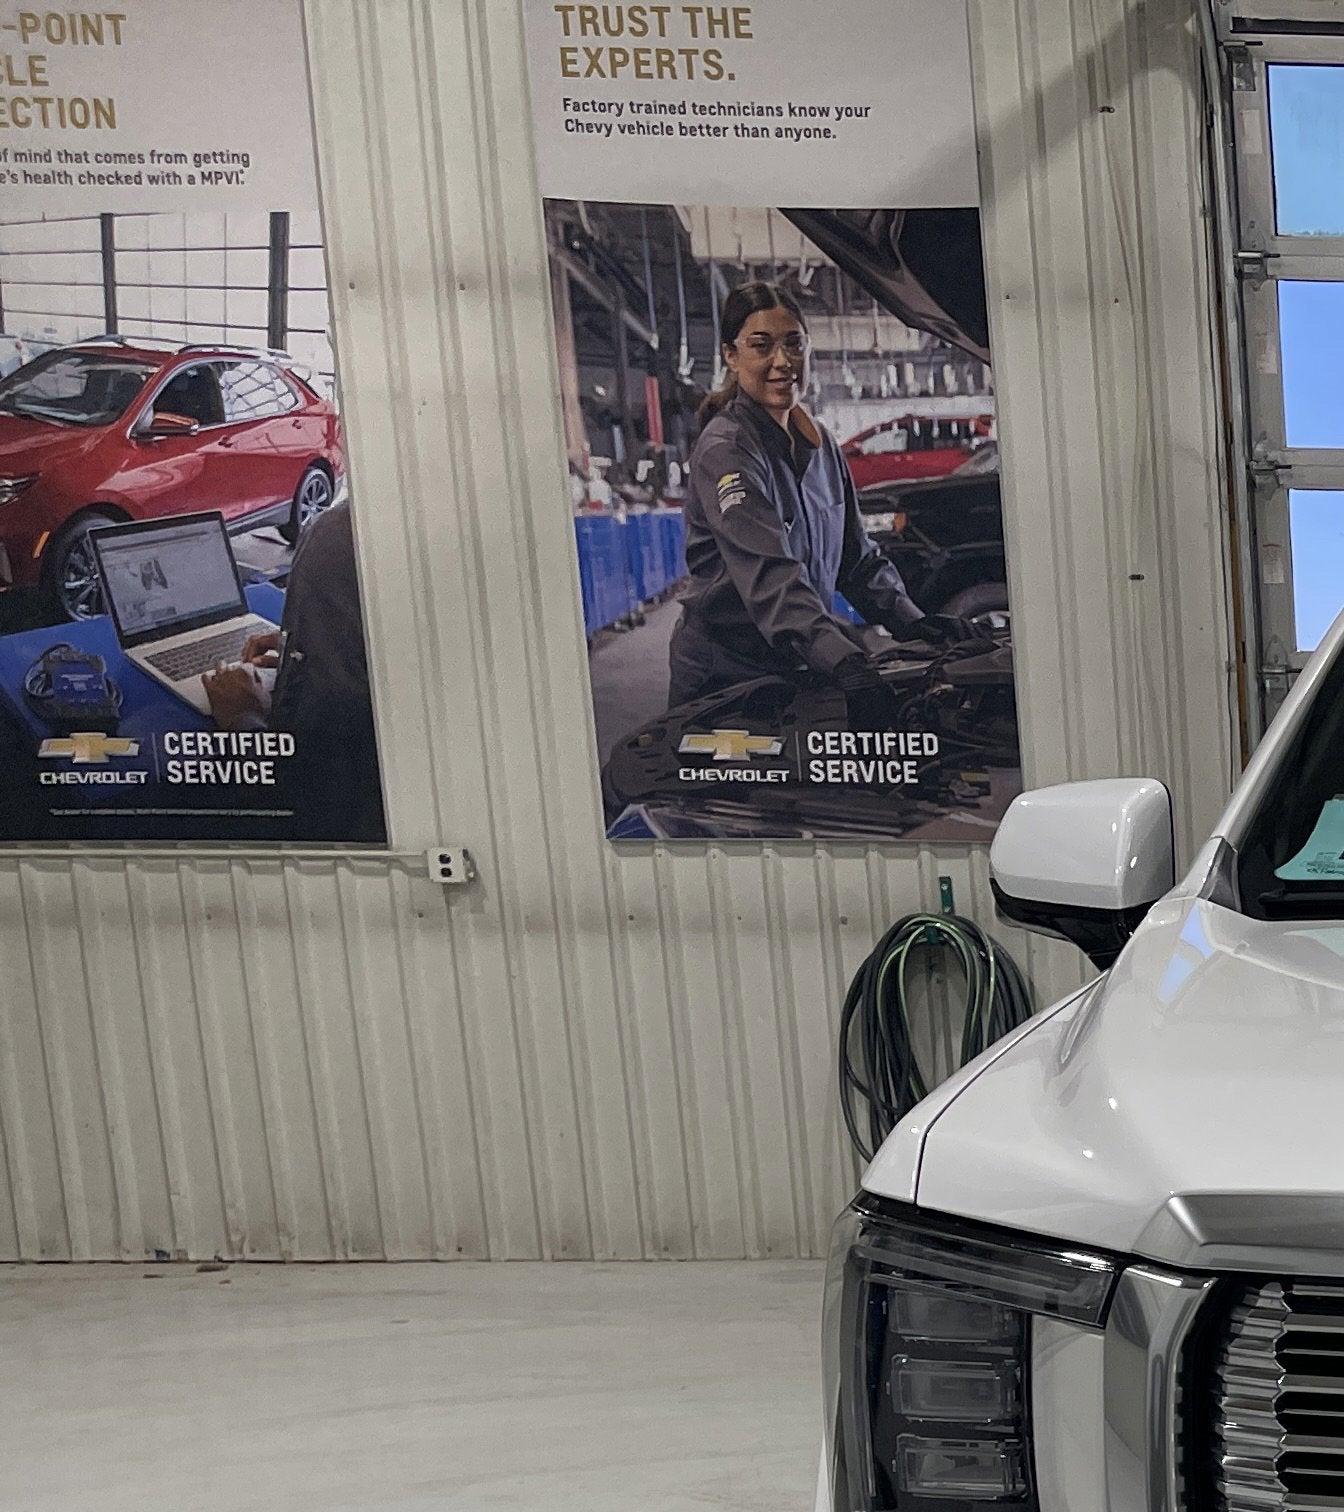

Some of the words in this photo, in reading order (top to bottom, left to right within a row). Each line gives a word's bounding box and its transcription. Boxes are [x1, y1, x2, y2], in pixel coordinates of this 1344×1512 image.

[554, 5, 671, 37] TRUST
[682, 6, 753, 39] THE
[0, 54, 49, 86] LE
[560, 46, 736, 81] EXPERTS.
[563, 98, 624, 117] Factory
[629, 100, 687, 115] trained
[692, 101, 784, 117] technicians
[788, 102, 830, 118] know
[835, 106, 871, 121] your
[564, 118, 613, 138] Chevy
[617, 120, 674, 136] vehicle
[679, 121, 729, 138] better
[733, 122, 770, 138] than
[775, 127, 837, 142] anyone.
[14, 149, 52, 163] mind
[57, 149, 90, 163] that
[94, 152, 145, 164] comes
[150, 149, 188, 164] from
[193, 149, 250, 168] getting
[24, 169, 73, 185] health
[78, 171, 143, 185] checked
[147, 171, 182, 185] with
[187, 174, 196, 185] a
[164, 732, 295, 757] CERTIFIED
[807, 731, 939, 756] CERTIFIED
[39, 771, 149, 785] CHEVROLET
[167, 760, 276, 785] SERVICE
[678, 768, 790, 783] CHEVROLET
[809, 759, 919, 784] SERVICE
